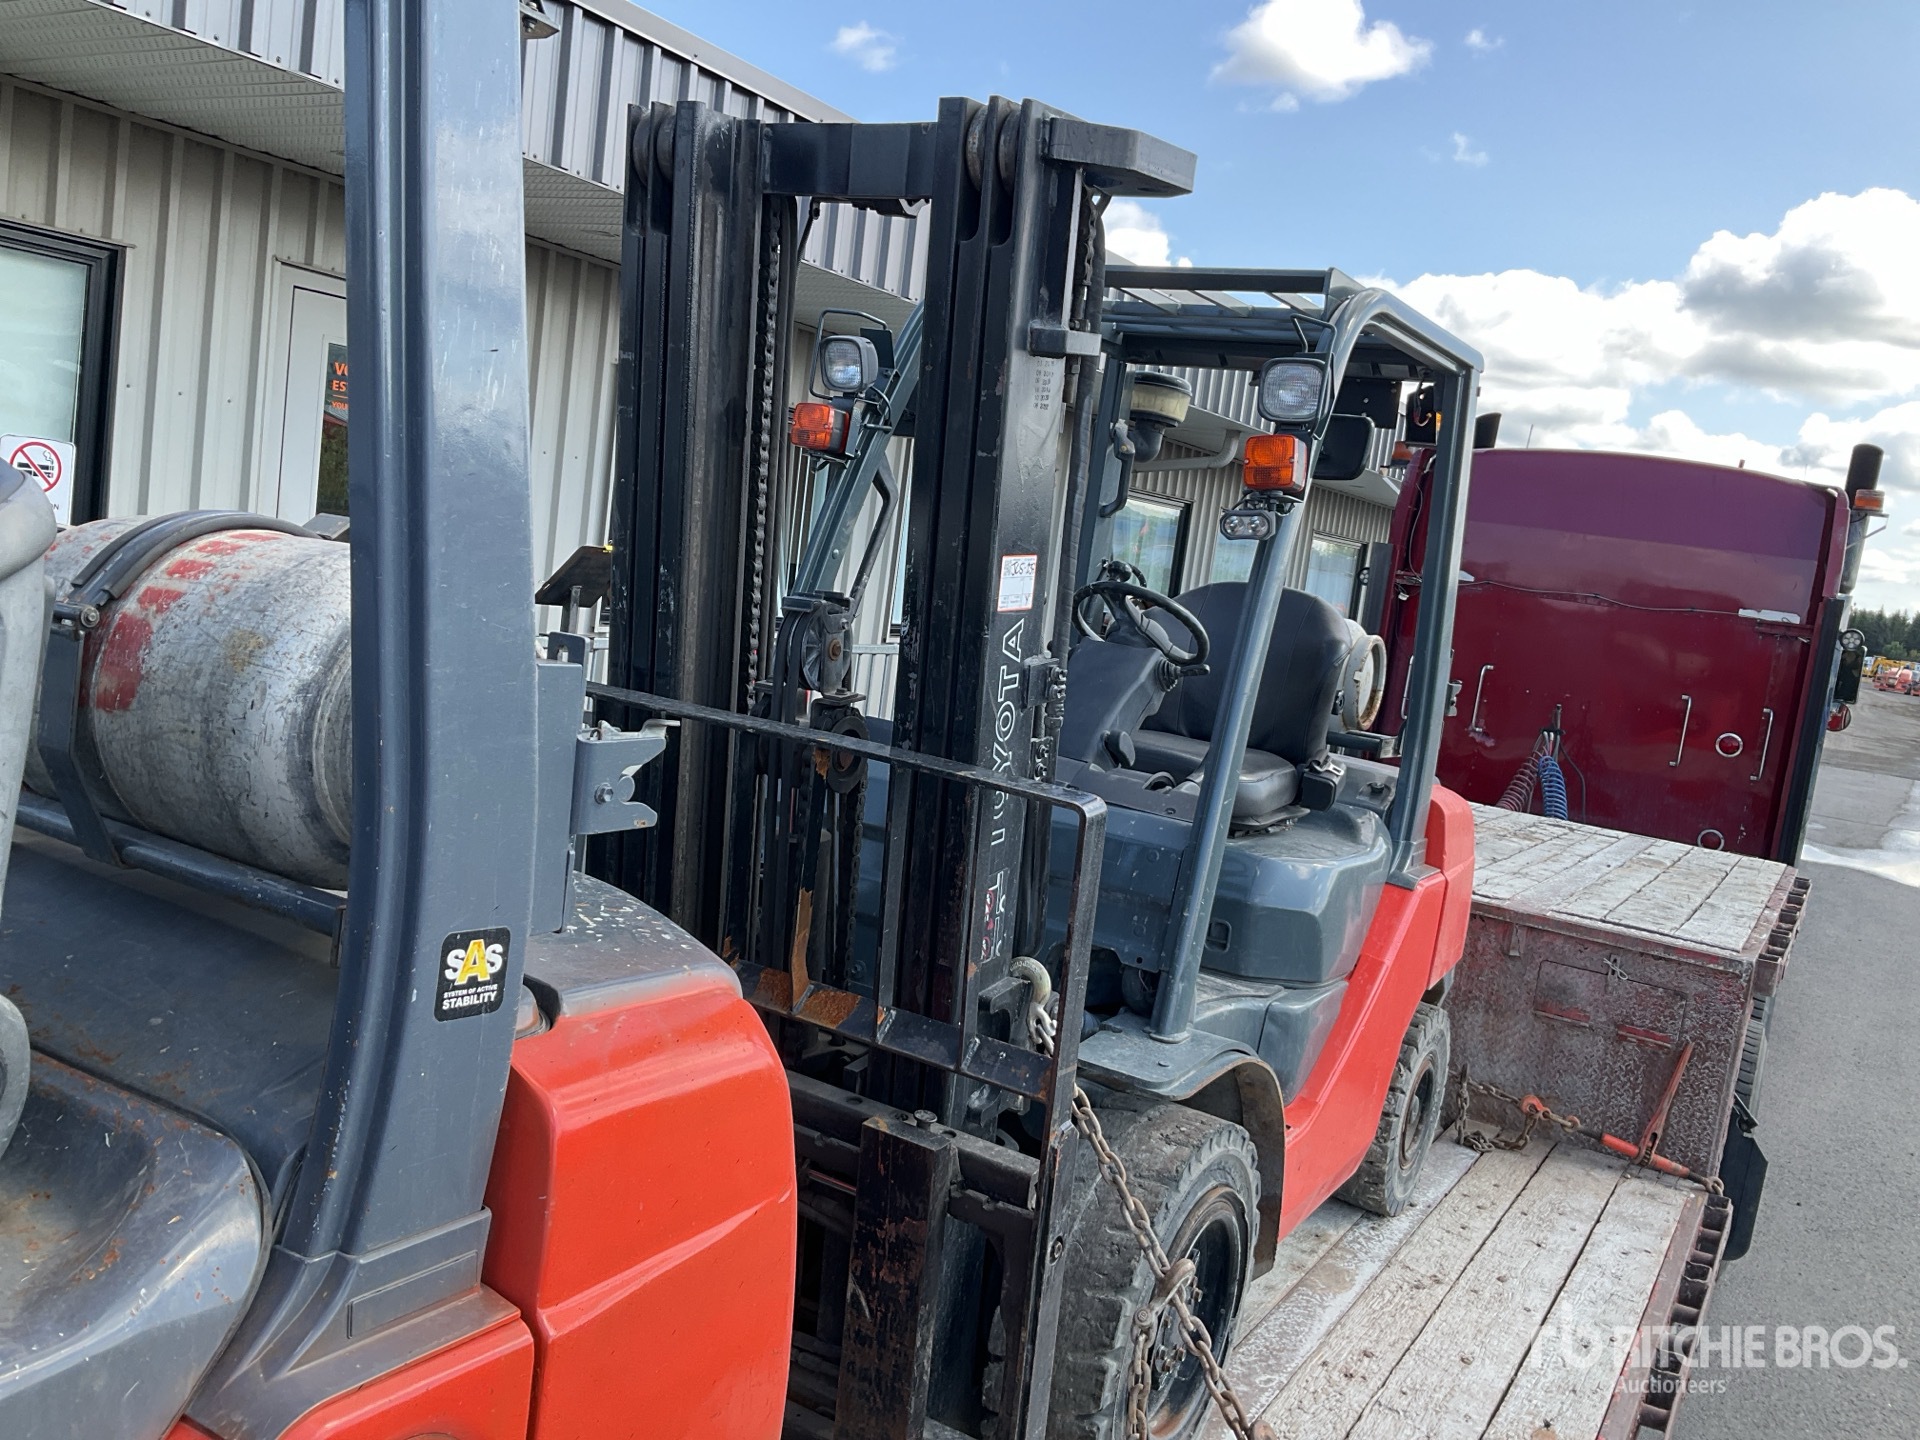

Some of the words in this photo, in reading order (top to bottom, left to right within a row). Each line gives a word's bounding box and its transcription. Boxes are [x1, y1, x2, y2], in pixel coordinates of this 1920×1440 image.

[444, 939, 504, 985] SAS
[442, 991, 498, 1010] STABILITY
[444, 989, 468, 998] SYSTEM
[468, 987, 476, 995] OF
[477, 984, 498, 992] ACTIVE
